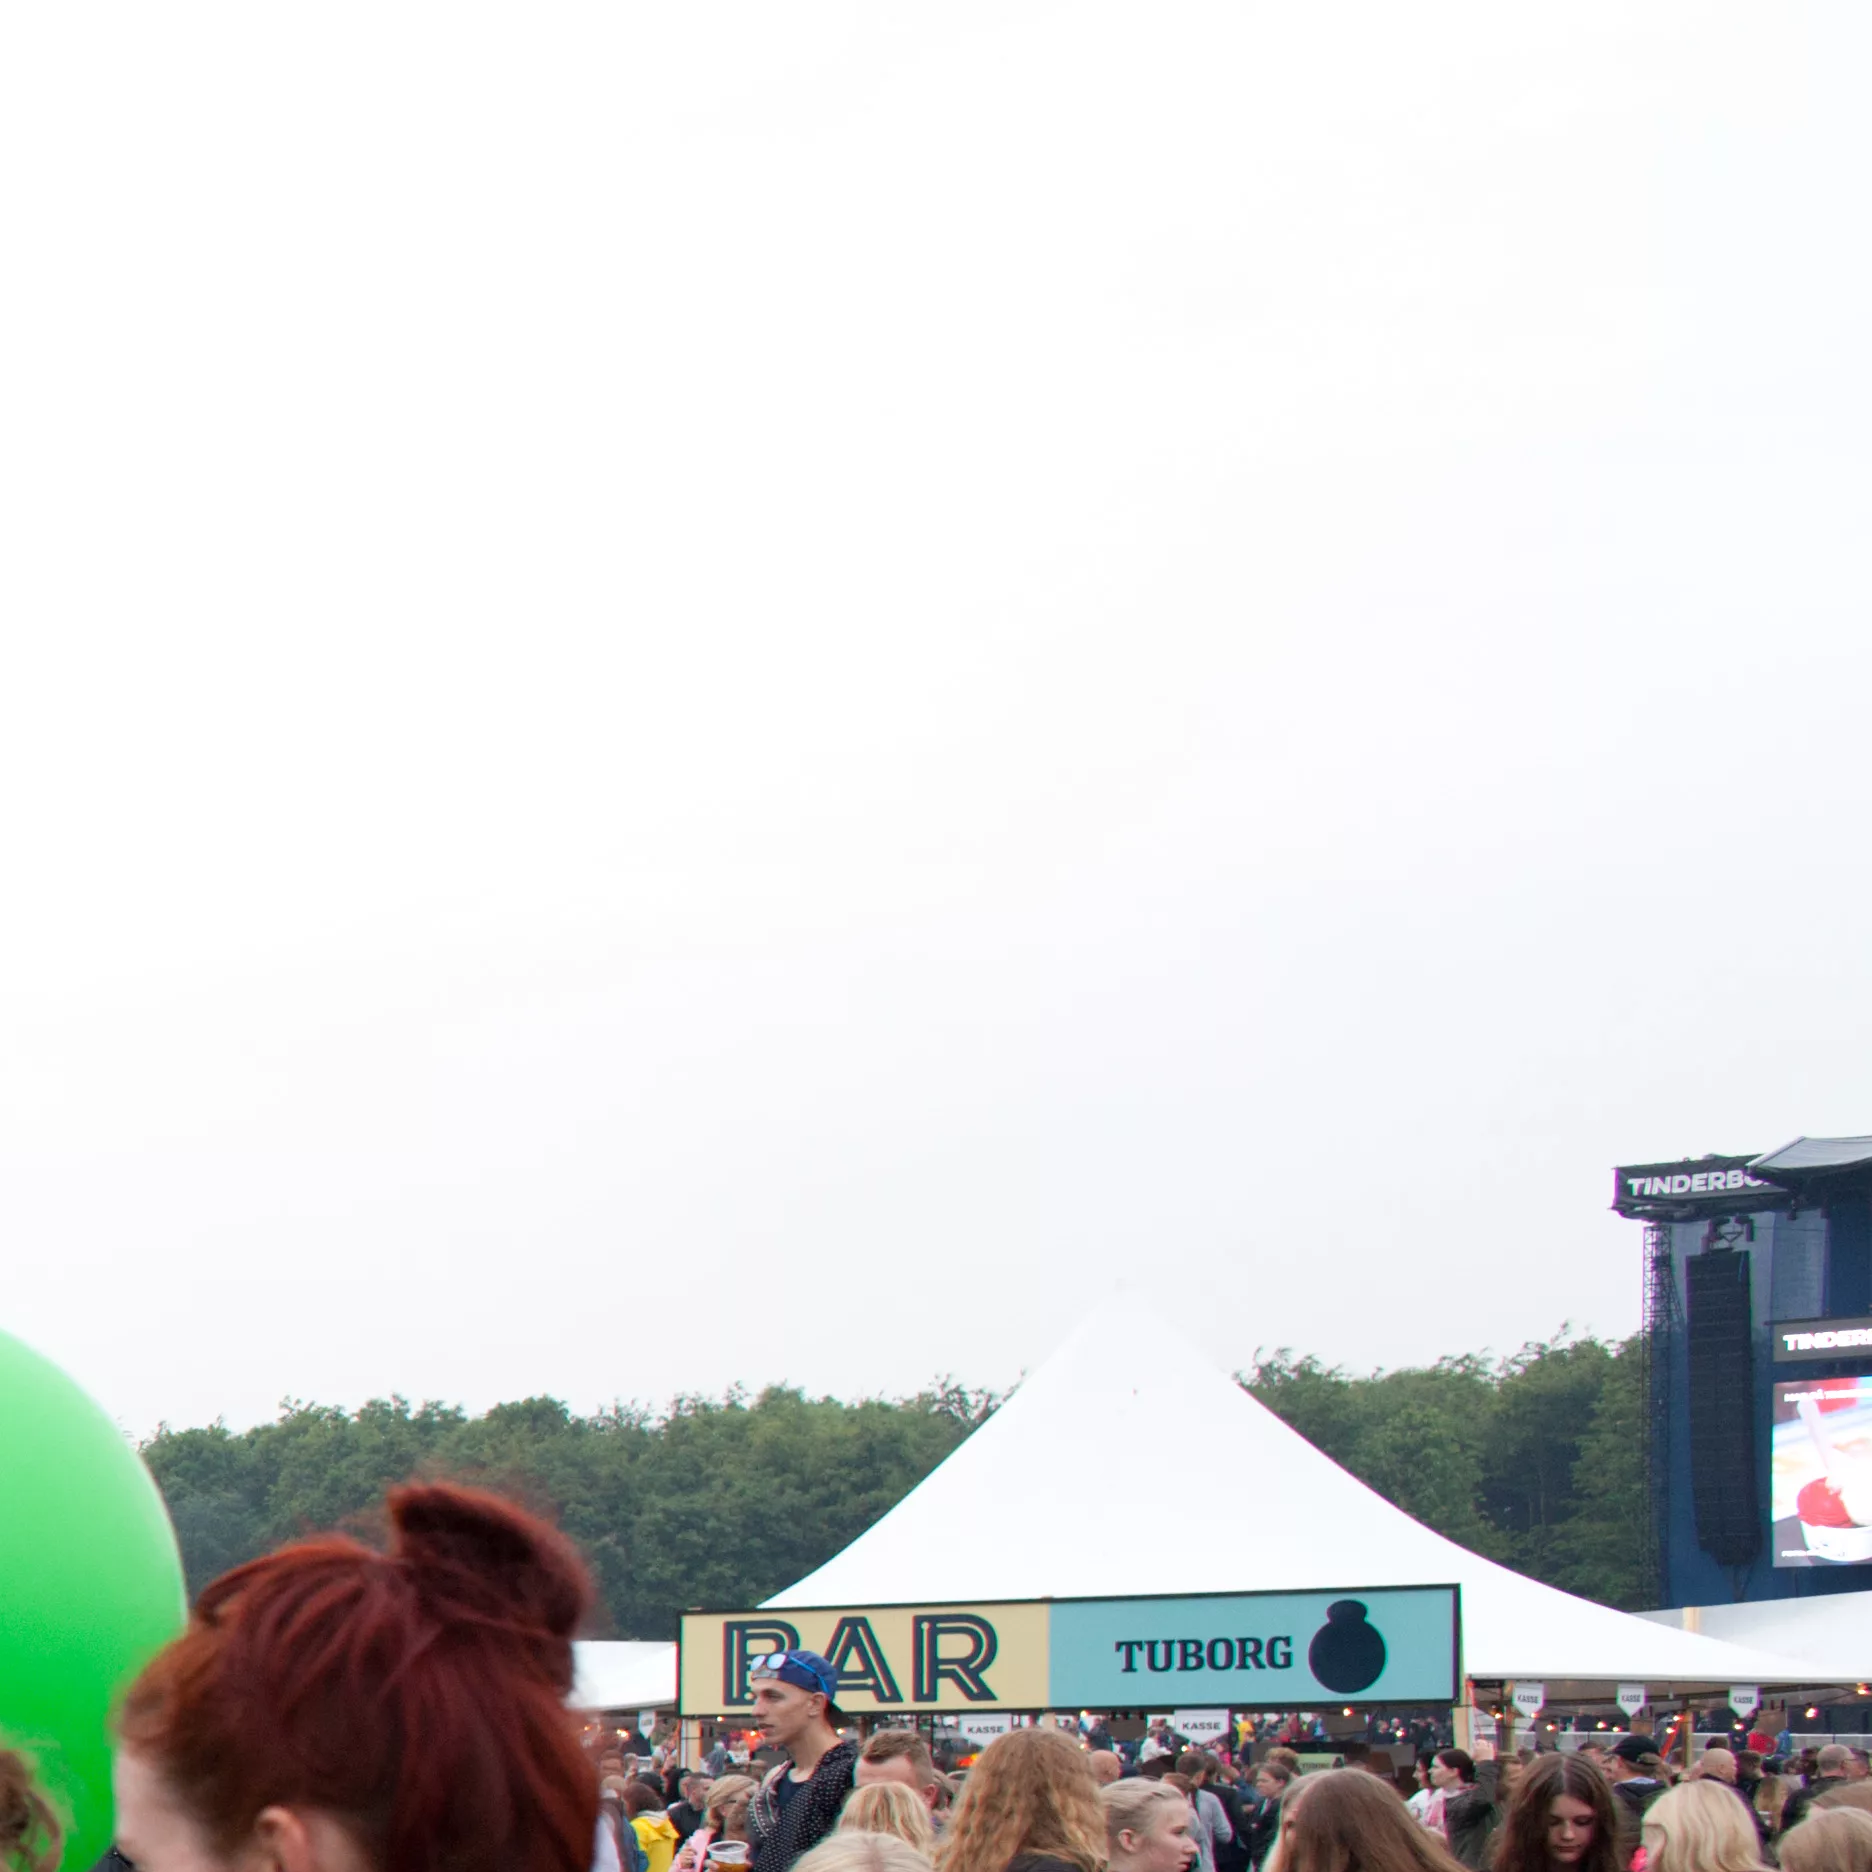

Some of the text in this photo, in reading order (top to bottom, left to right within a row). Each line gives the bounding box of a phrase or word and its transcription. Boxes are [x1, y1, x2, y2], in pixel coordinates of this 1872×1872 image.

[1627, 1169, 1770, 1196] TINDERB
[721, 1614, 998, 1706] BAR
[1115, 1635, 1292, 1673] TUBORG
[967, 1724, 1004, 1734] KASSE
[1182, 1721, 1222, 1731] KASSE
